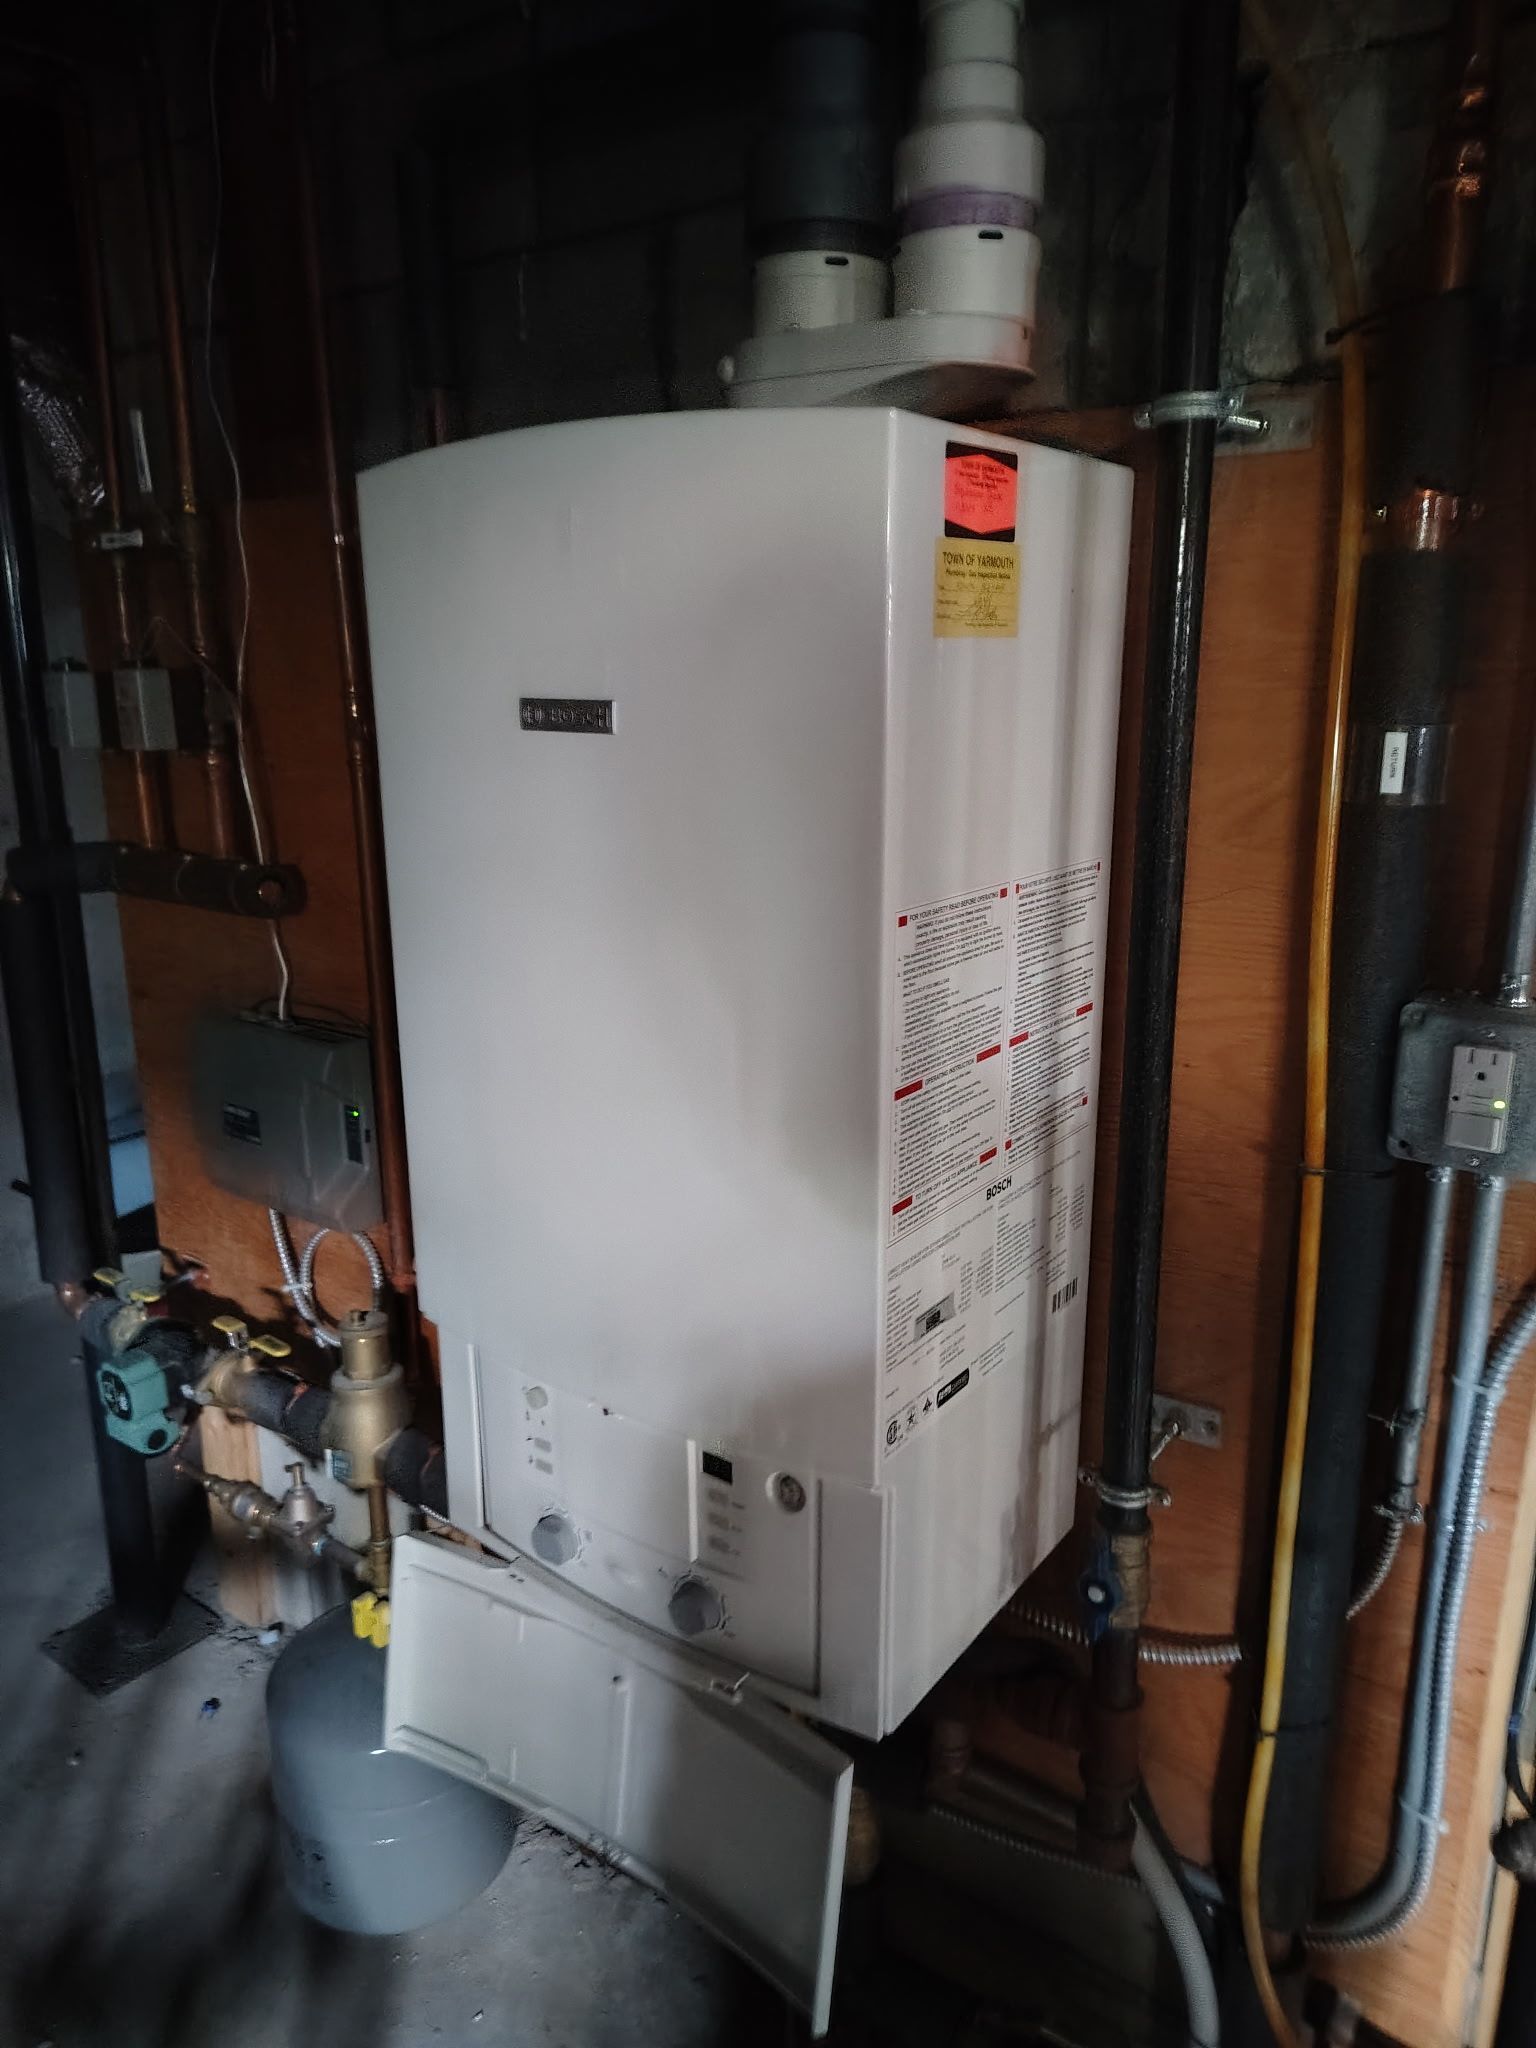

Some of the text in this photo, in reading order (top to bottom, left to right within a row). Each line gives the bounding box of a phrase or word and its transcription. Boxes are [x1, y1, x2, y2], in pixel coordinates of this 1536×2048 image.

[942, 551, 1014, 569] TOWN OF YARMOUTH
[909, 913, 919, 922] FOR
[919, 909, 932, 920] YOUR
[932, 904, 949, 916] SAFETY
[986, 1175, 1012, 1201] BOSCH
